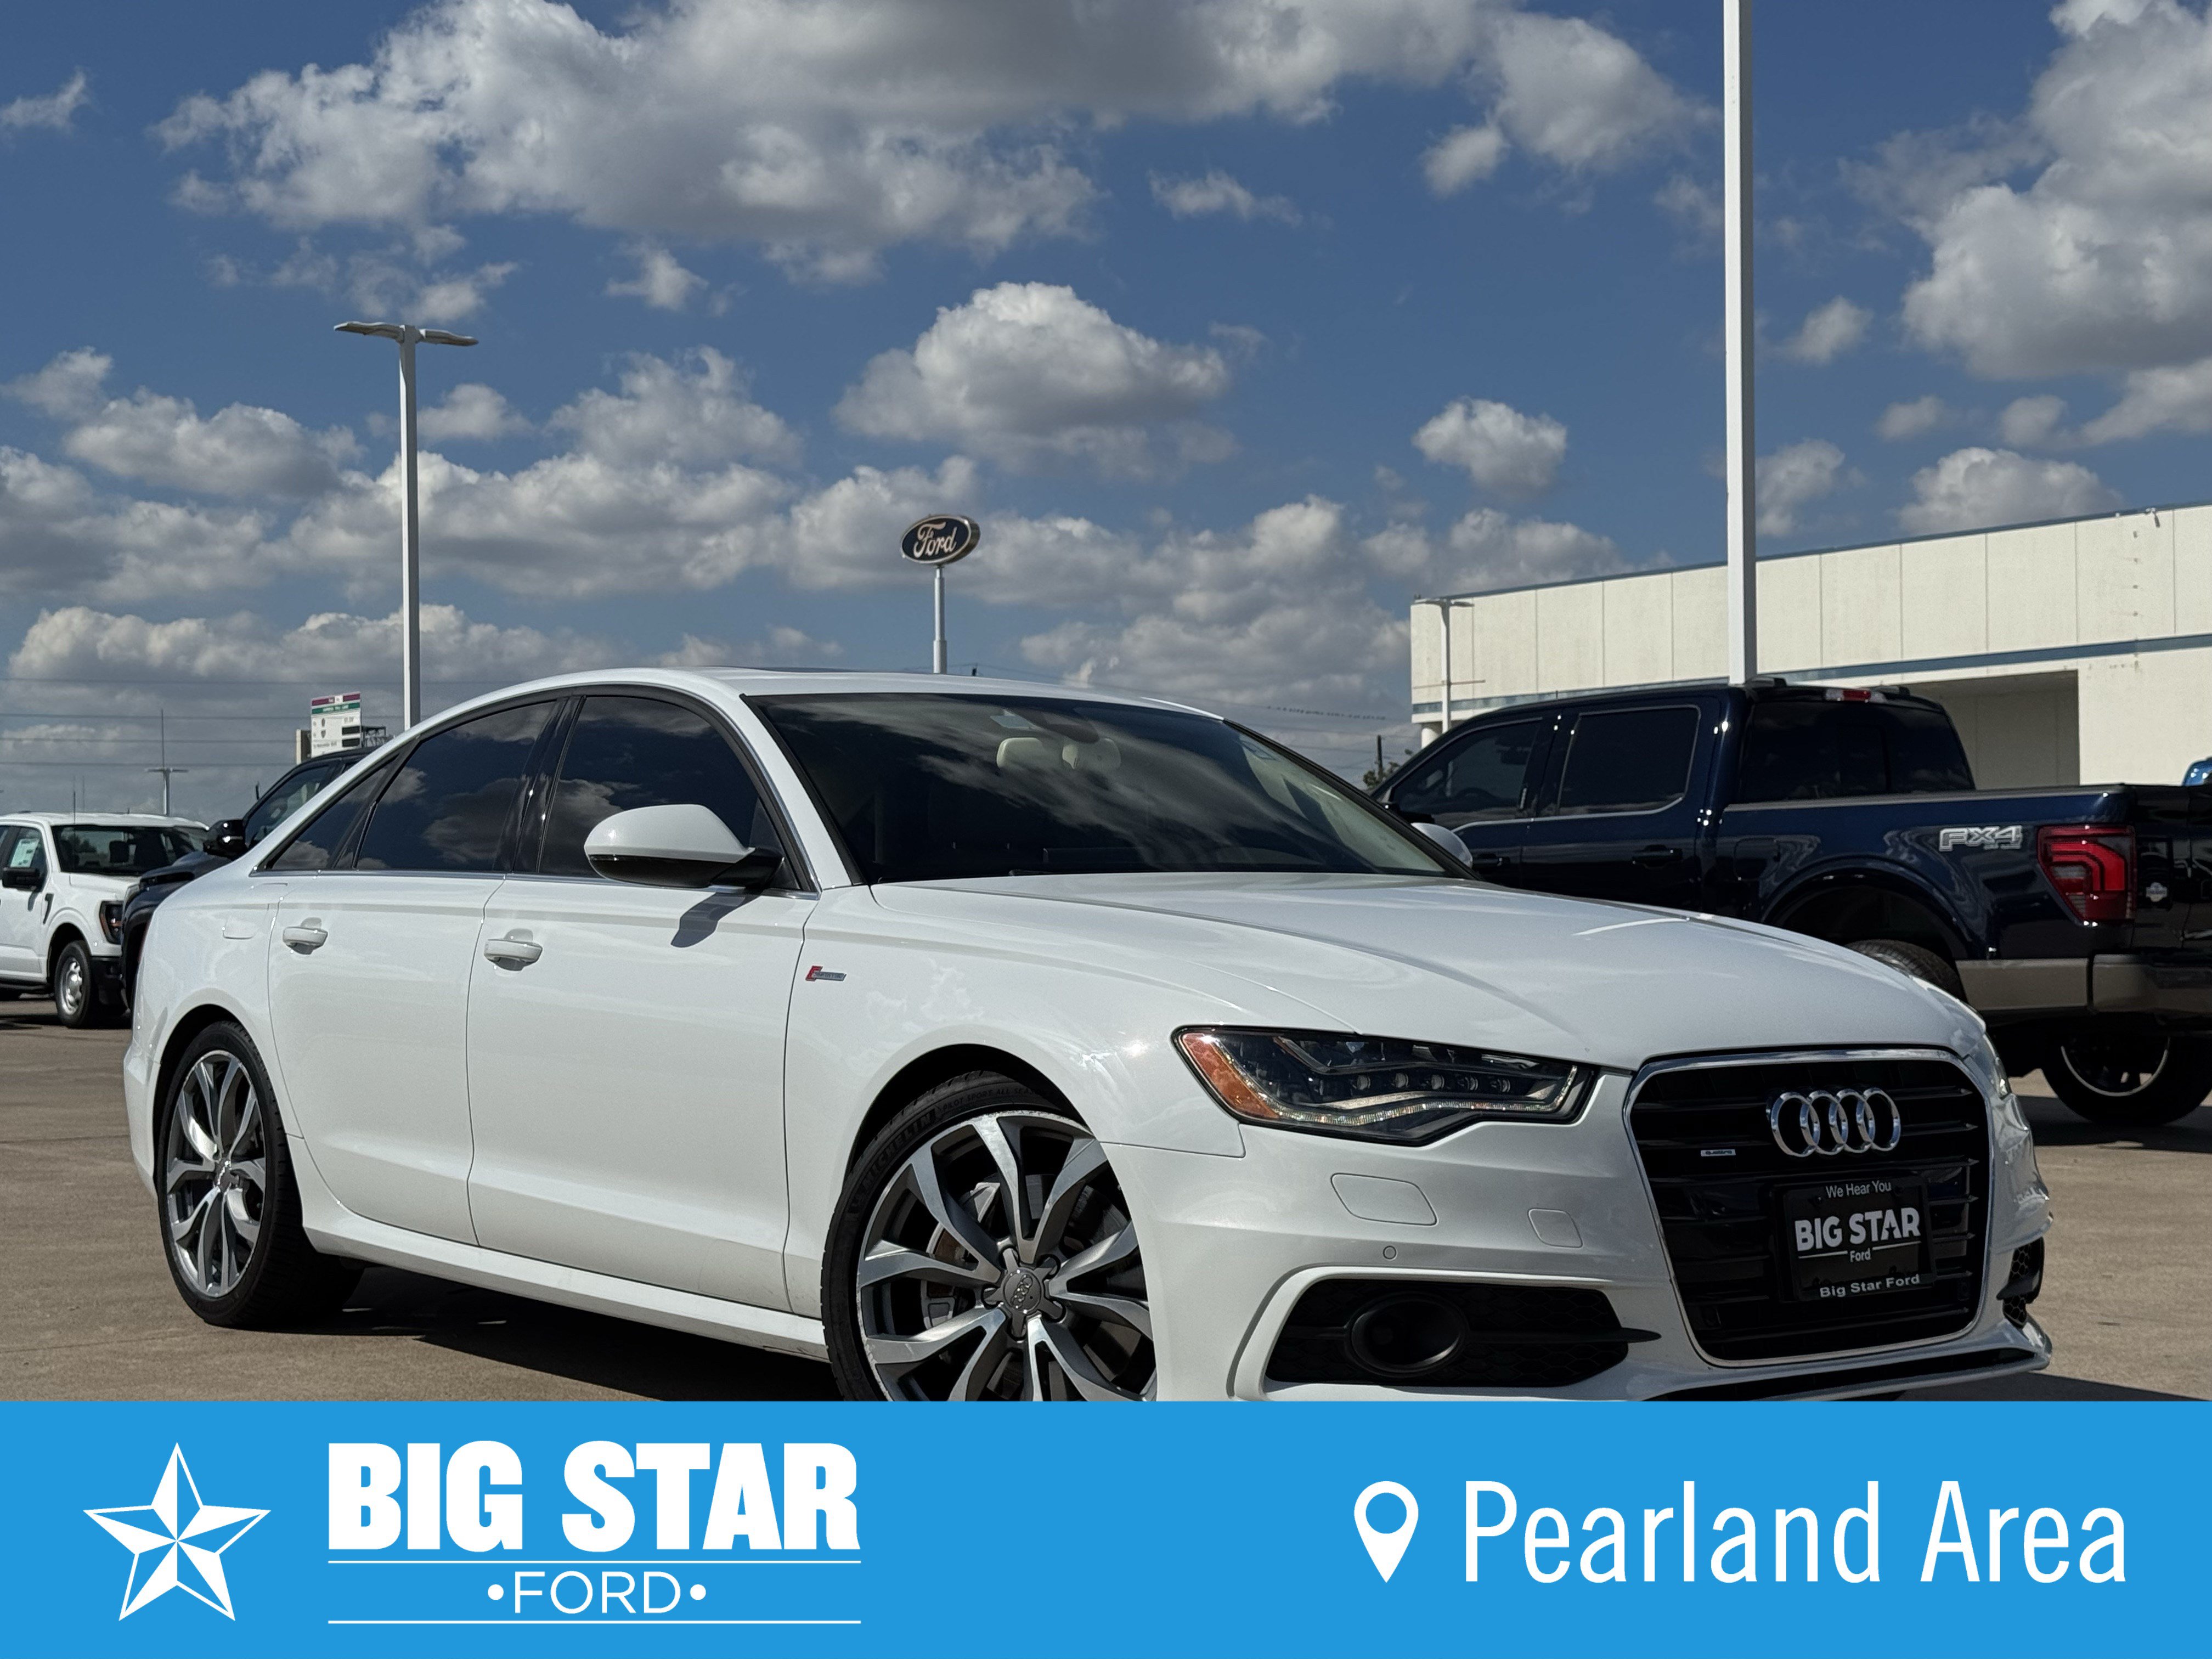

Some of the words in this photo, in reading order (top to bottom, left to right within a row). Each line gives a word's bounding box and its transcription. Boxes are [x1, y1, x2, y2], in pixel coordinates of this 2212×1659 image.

[913, 521, 958, 558] Ford
[1939, 825, 2023, 851] FX4
[967, 1089, 993, 1102] SPORT
[862, 1112, 933, 1189] MICHELIN
[1825, 1186, 1844, 1199] We
[1846, 1183, 1871, 1196] Hear
[1871, 1180, 1892, 1193] You
[1795, 1216, 1843, 1252] BIG
[1848, 1207, 1921, 1245] STAR
[1850, 1248, 1872, 1263] Ford
[1820, 1285, 1847, 1299] Big
[1850, 1281, 1882, 1294] Star
[1886, 1273, 1920, 1288] Ford
